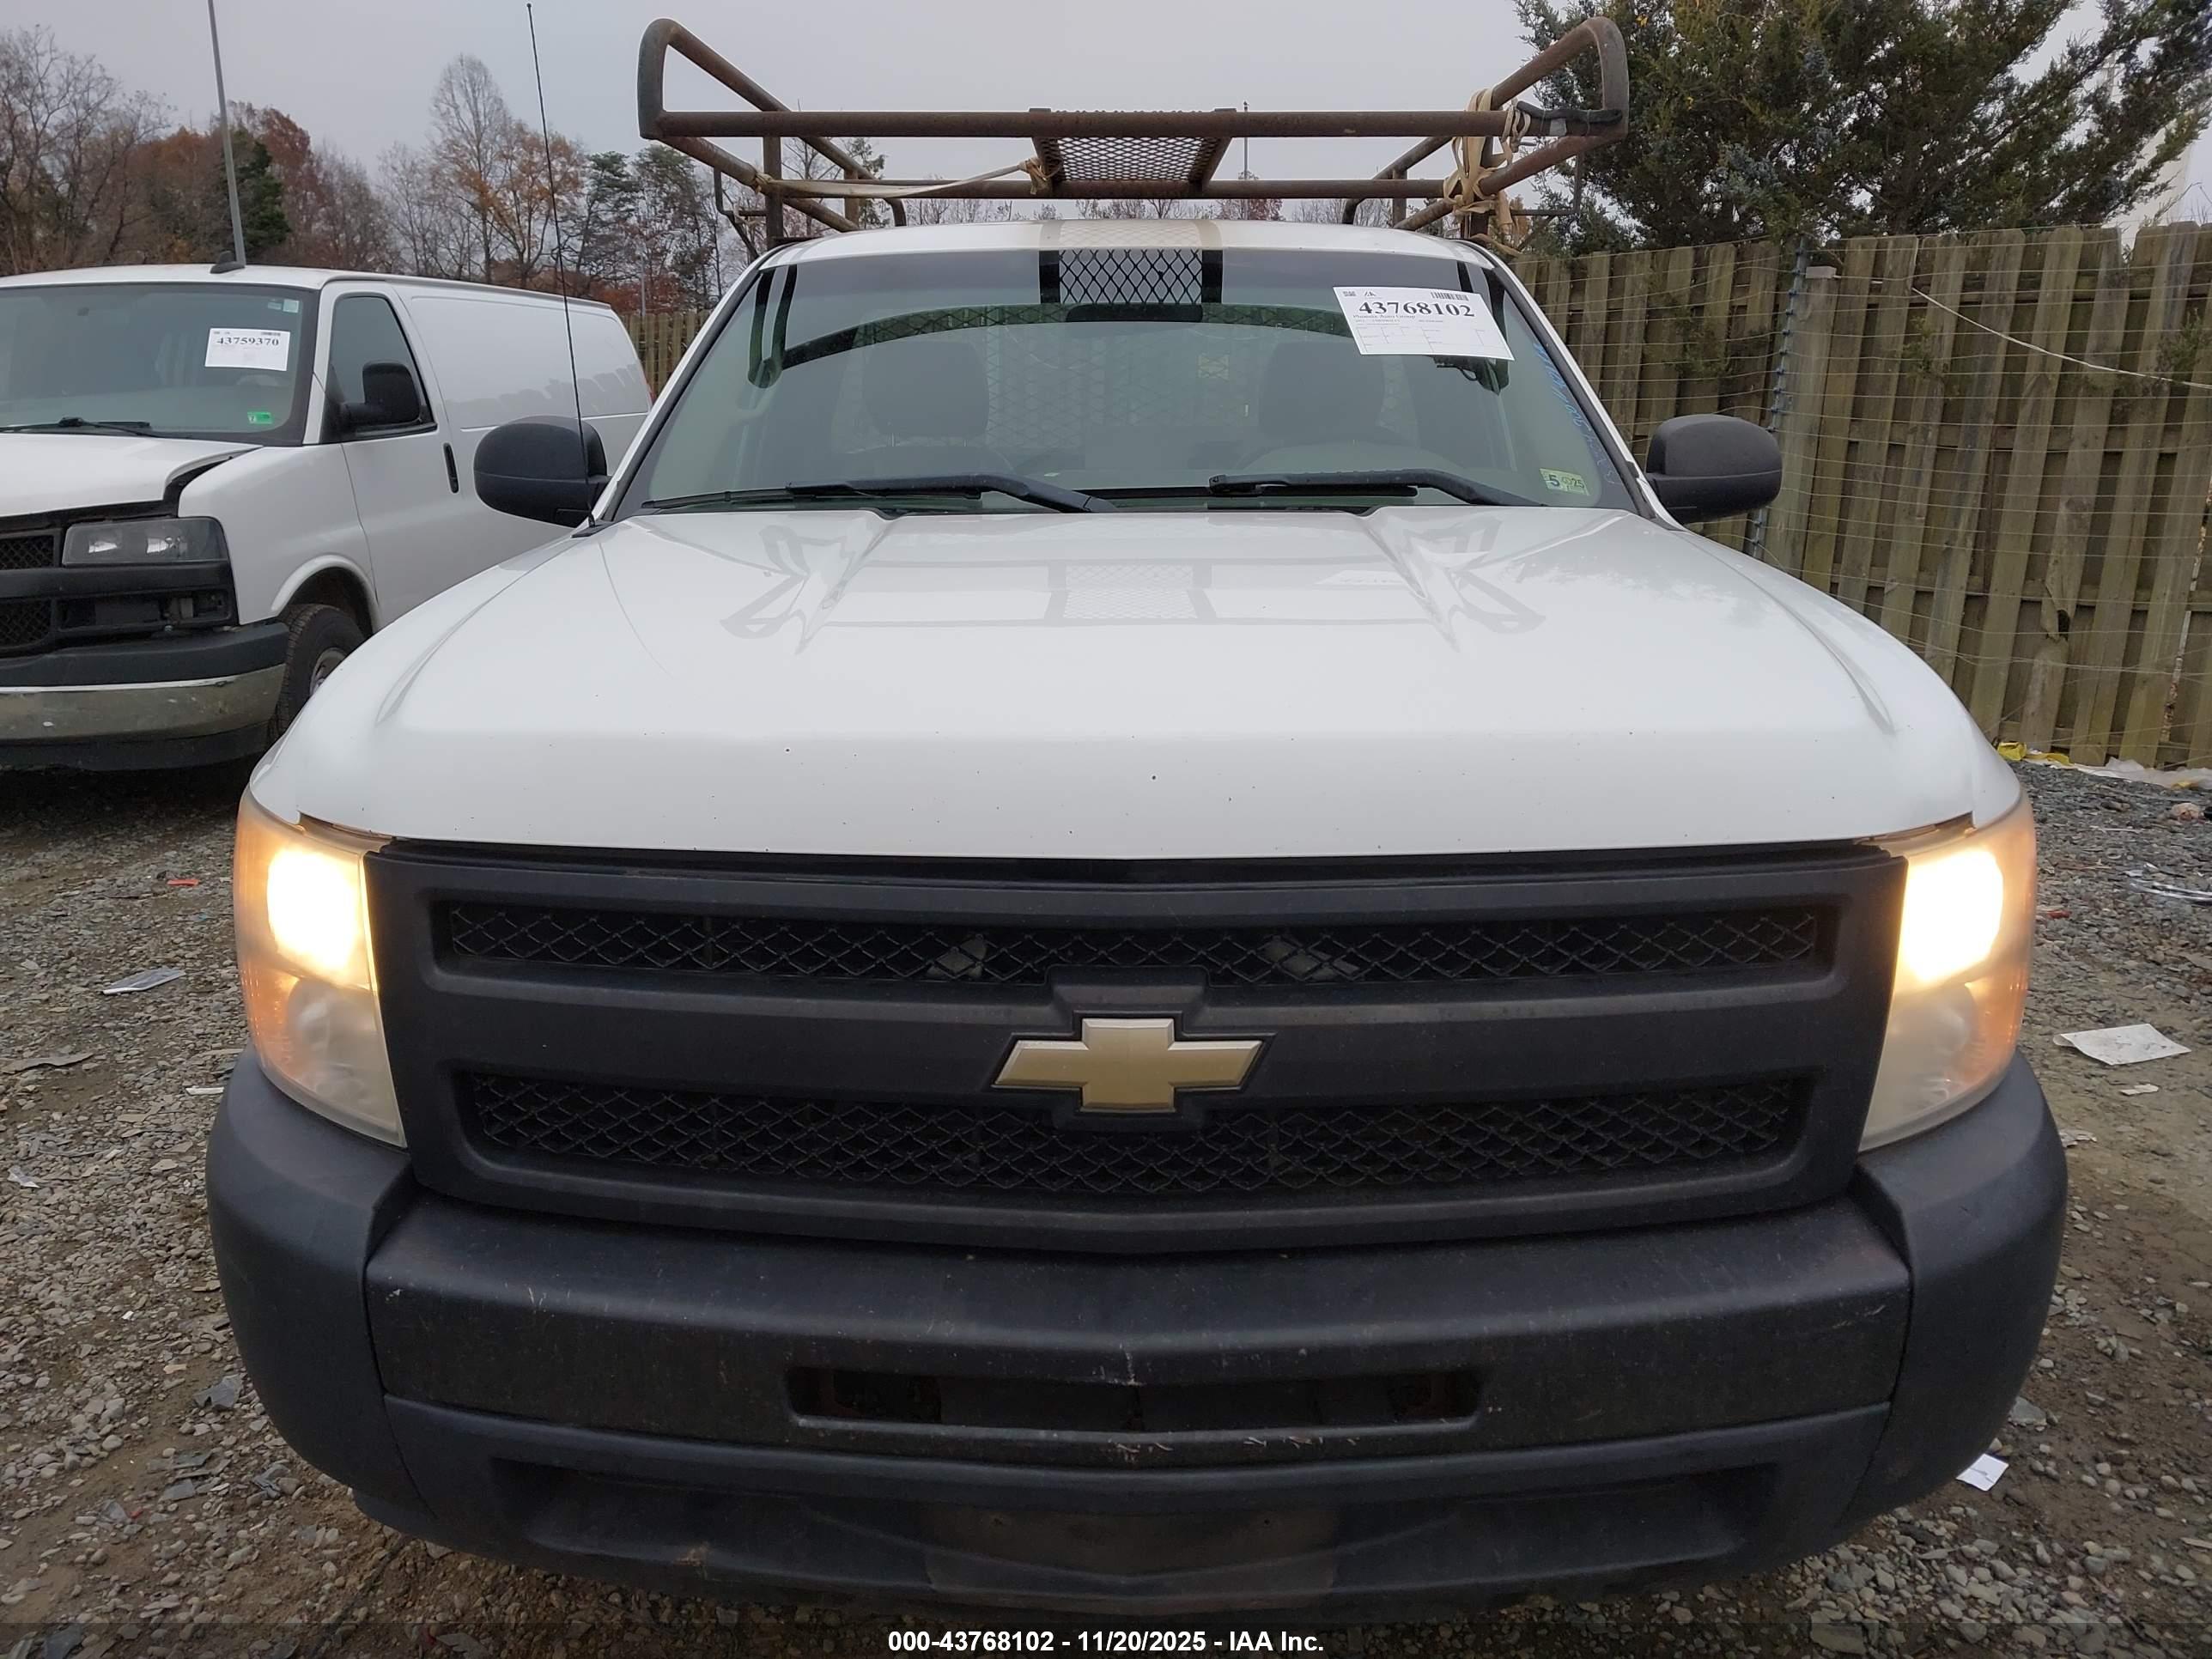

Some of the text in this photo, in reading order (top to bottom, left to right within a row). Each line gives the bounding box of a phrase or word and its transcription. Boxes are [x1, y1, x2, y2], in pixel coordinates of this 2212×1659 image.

[1358, 301, 1475, 317] 43768102
[216, 337, 279, 346] 43759370
[1548, 474, 1560, 487] 5
